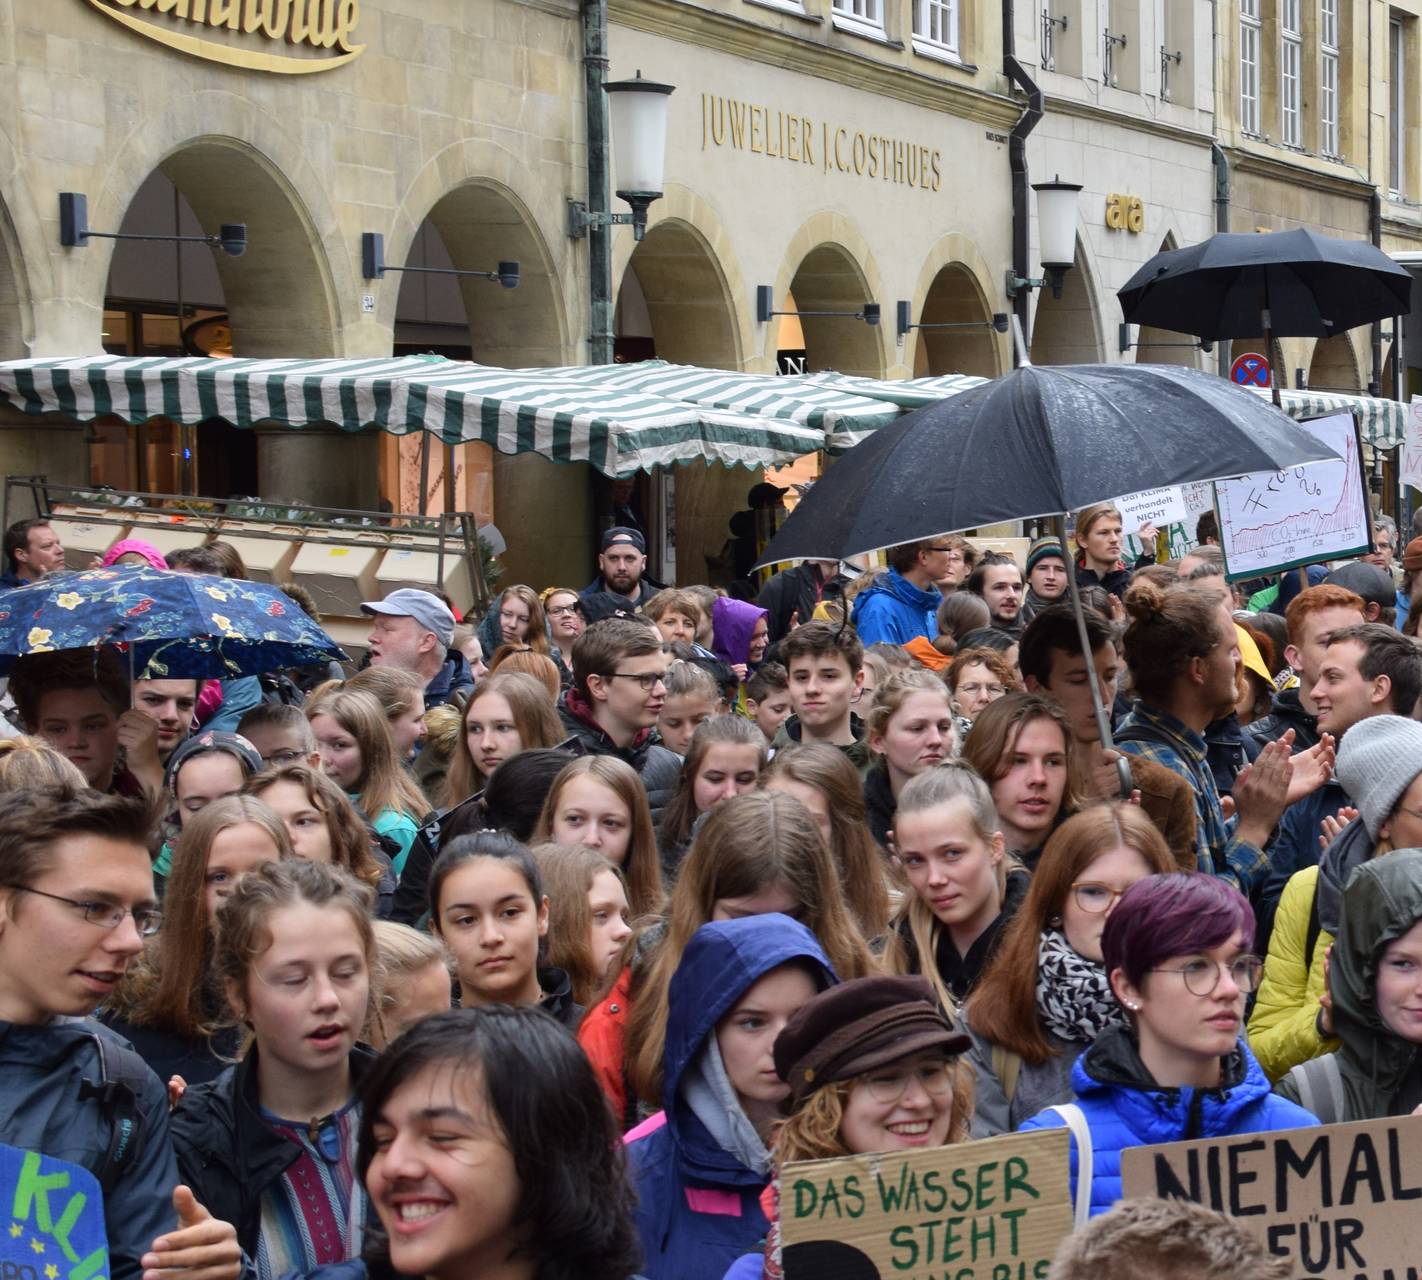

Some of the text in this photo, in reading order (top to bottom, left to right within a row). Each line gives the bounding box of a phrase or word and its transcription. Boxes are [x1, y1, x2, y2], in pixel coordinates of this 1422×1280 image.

[702, 93, 815, 165] JUWELIER
[1105, 193, 1143, 232] ara
[1125, 496, 1173, 513] verhandelt
[1137, 509, 1166, 523] NICHT
[792, 1156, 1041, 1219] DAS WASSER
[889, 1208, 1027, 1270] STEHT
